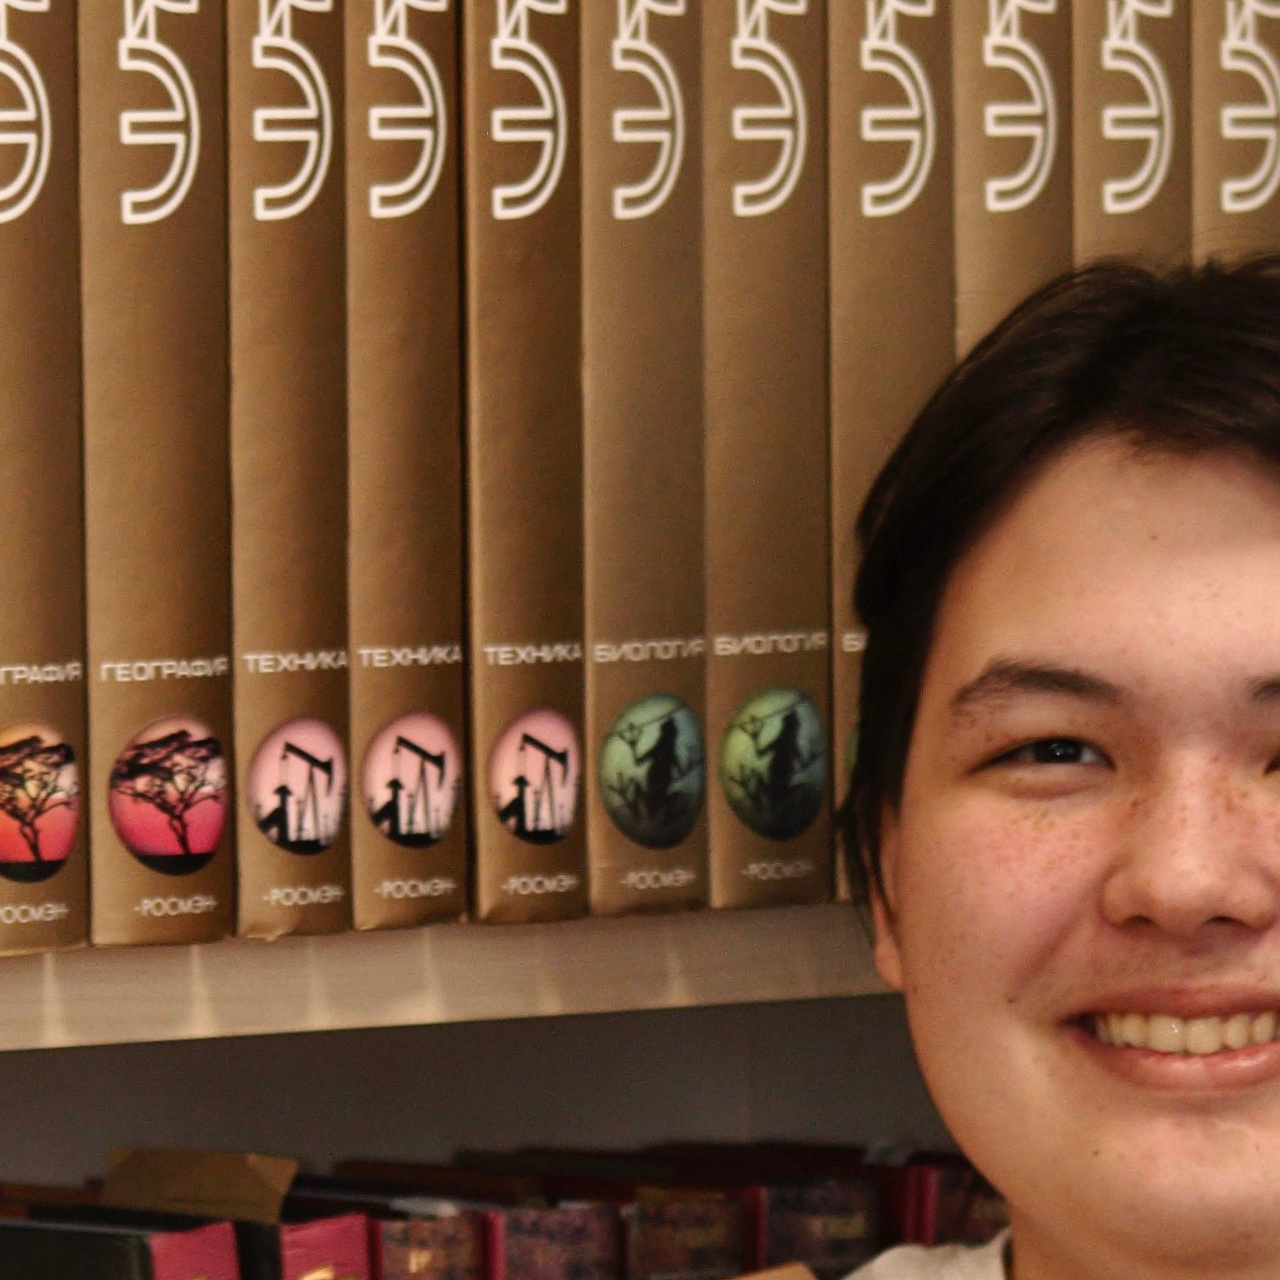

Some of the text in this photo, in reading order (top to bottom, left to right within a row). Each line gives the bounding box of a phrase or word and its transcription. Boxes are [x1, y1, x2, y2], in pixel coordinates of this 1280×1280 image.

[243, 650, 348, 673] ТЕХНИКА
[358, 645, 462, 668] ТЕХНИКА
[483, 643, 582, 666] ТЕХНИКА
